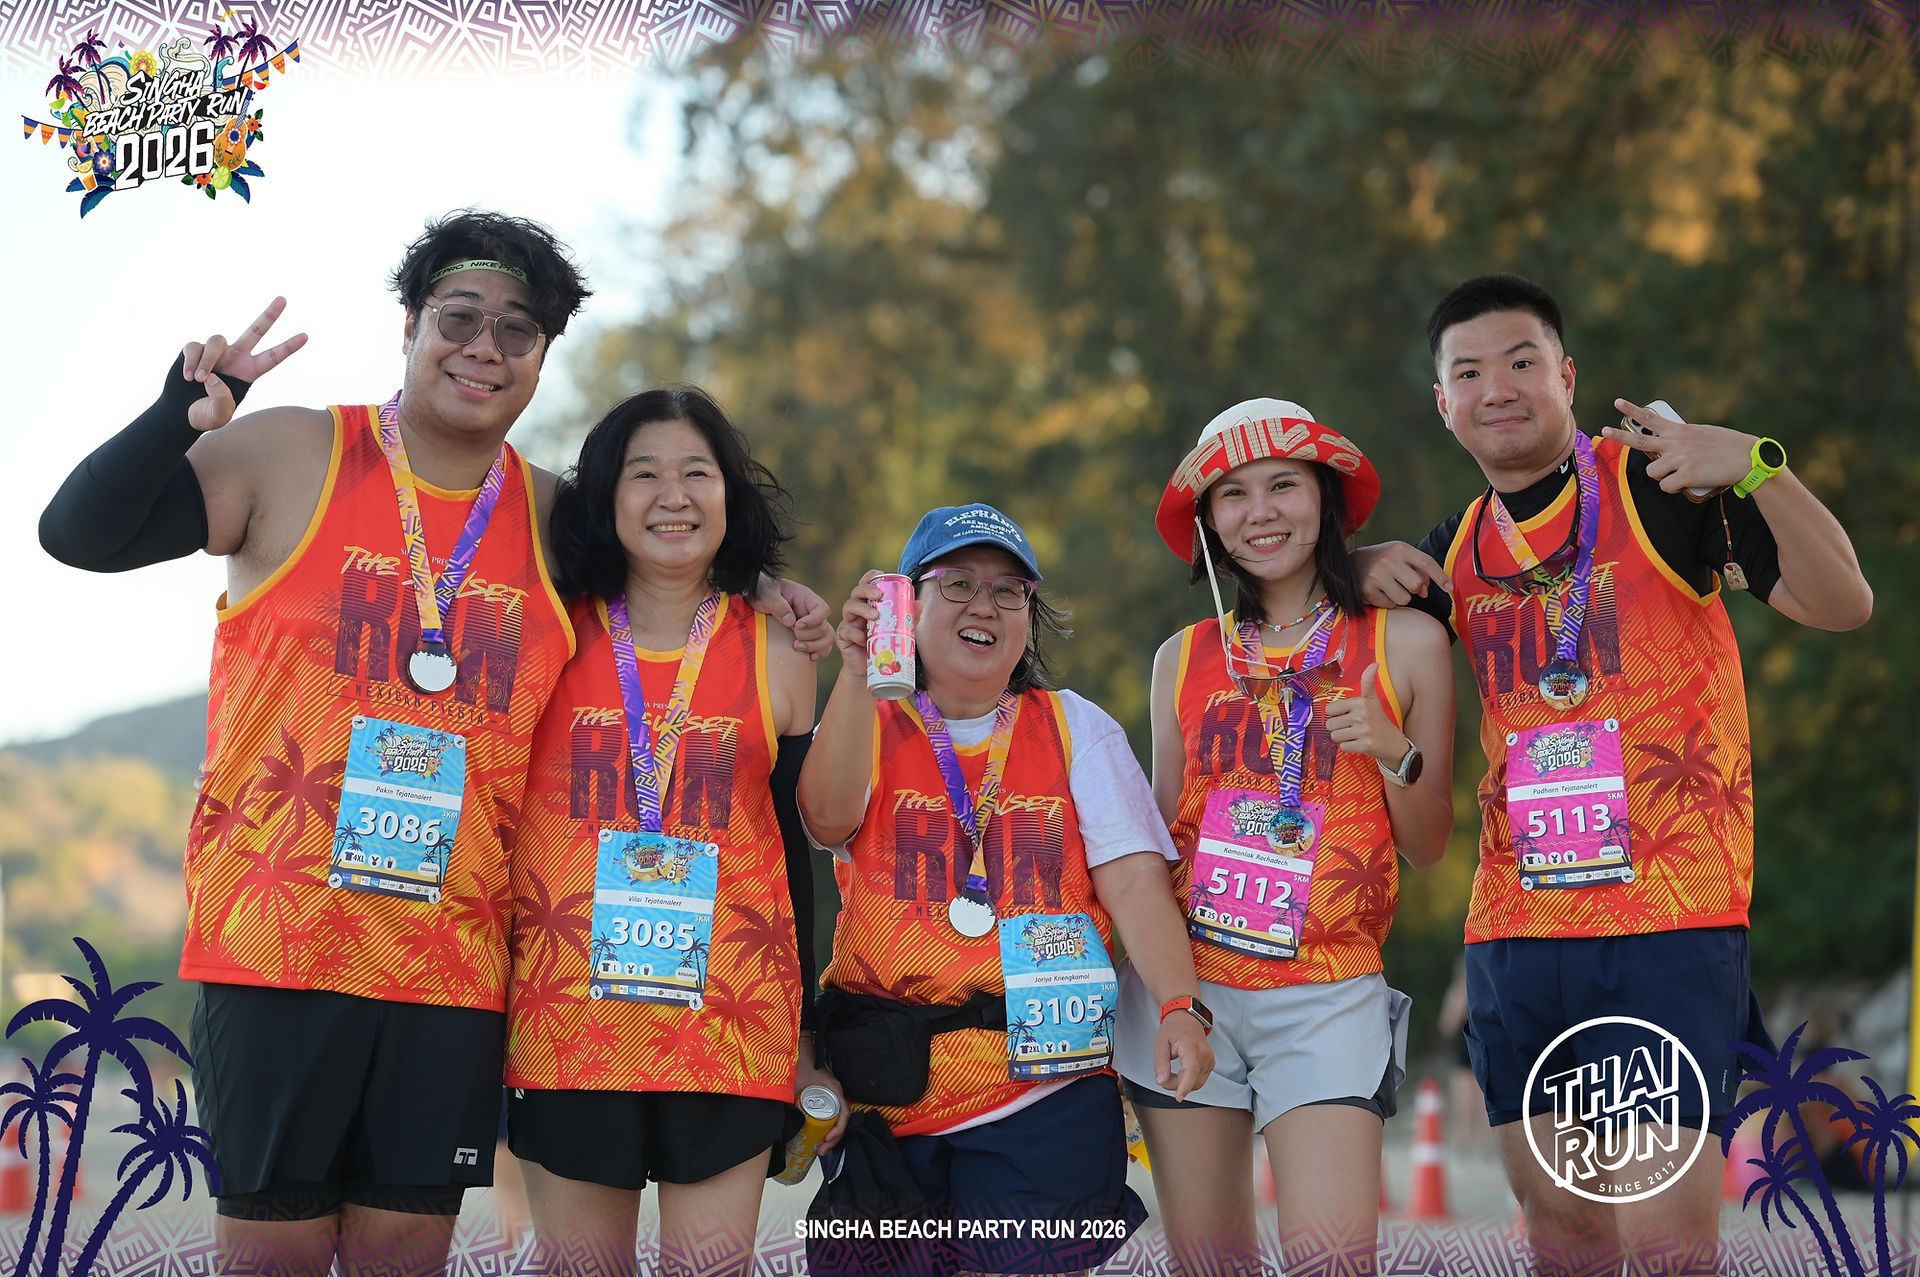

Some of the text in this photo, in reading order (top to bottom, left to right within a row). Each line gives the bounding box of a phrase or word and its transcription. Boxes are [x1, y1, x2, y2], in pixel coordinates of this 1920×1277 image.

[944, 509, 1022, 542] ELEPHANTS
[341, 546, 400, 575] THE
[334, 562, 524, 714] RUN
[355, 684, 484, 725] MEXICAN FIESTA
[569, 706, 624, 732] THE
[393, 756, 428, 772] 2026
[570, 712, 738, 829] RUN
[1548, 749, 1580, 771] 2026
[376, 786, 393, 795] Pakin
[893, 789, 948, 815] THE
[1607, 792, 1624, 800] 5KM
[356, 807, 441, 847] 3086
[442, 811, 459, 819] 3KM
[1246, 820, 1272, 836] 202
[1528, 804, 1612, 838] 5113
[353, 854, 364, 863] 4XL
[894, 800, 1065, 909] RUN
[1208, 867, 1292, 910] 5112
[1293, 875, 1310, 884] 5KM
[695, 915, 710, 923] 3KM
[610, 917, 696, 951] 3085
[1046, 939, 1075, 960] 2026
[1025, 995, 1103, 1026] 3105
[1029, 1045, 1040, 1053] 2XL
